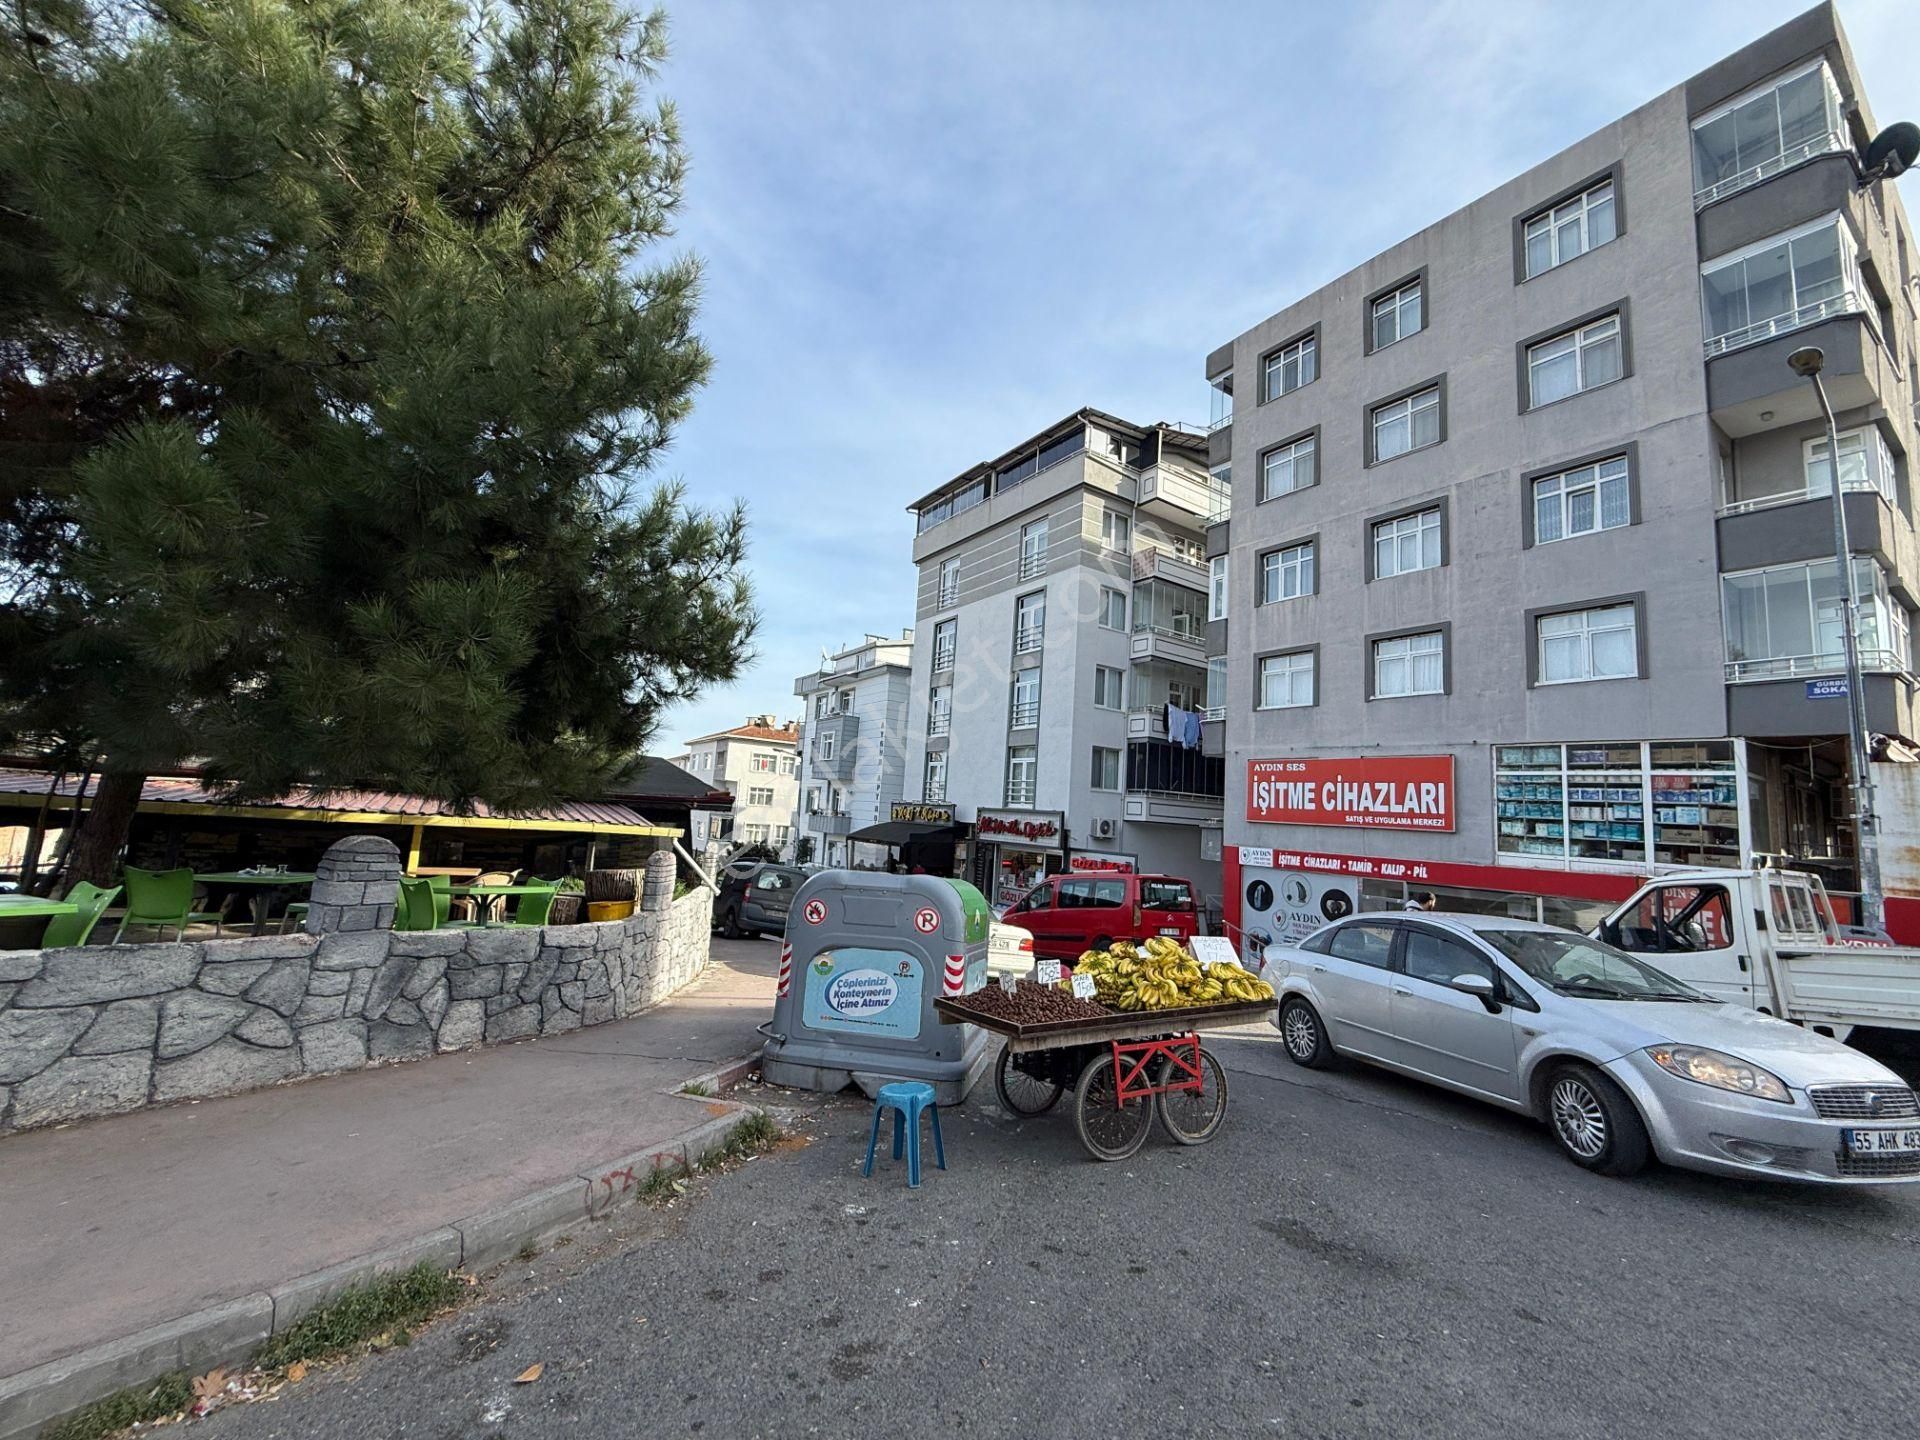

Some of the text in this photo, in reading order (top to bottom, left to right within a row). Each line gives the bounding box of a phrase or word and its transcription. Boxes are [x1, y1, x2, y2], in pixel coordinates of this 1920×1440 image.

[1813, 686, 1848, 694] SOKA
[1253, 763, 1306, 772] AYDIN SES
[1252, 774, 1446, 815] İŞİTME CİHAZLARI
[1345, 815, 1446, 827] SATIŞ VE UYGULAMA MERKEZİ
[1278, 852, 1301, 868] İŞİTME
[1303, 853, 1341, 871] CİHAZLARI
[1347, 858, 1373, 873] TAMİR
[1380, 863, 1406, 876] KALIP
[1412, 863, 1428, 879] PİL
[1289, 912, 1321, 924] AYDIN
[837, 976, 889, 989] Çöplerinizi
[833, 988, 892, 1000] Konteynerin
[860, 998, 890, 1008] Atınız
[1854, 1132, 1872, 1150] 55
[1878, 1132, 1900, 1150] AHK
